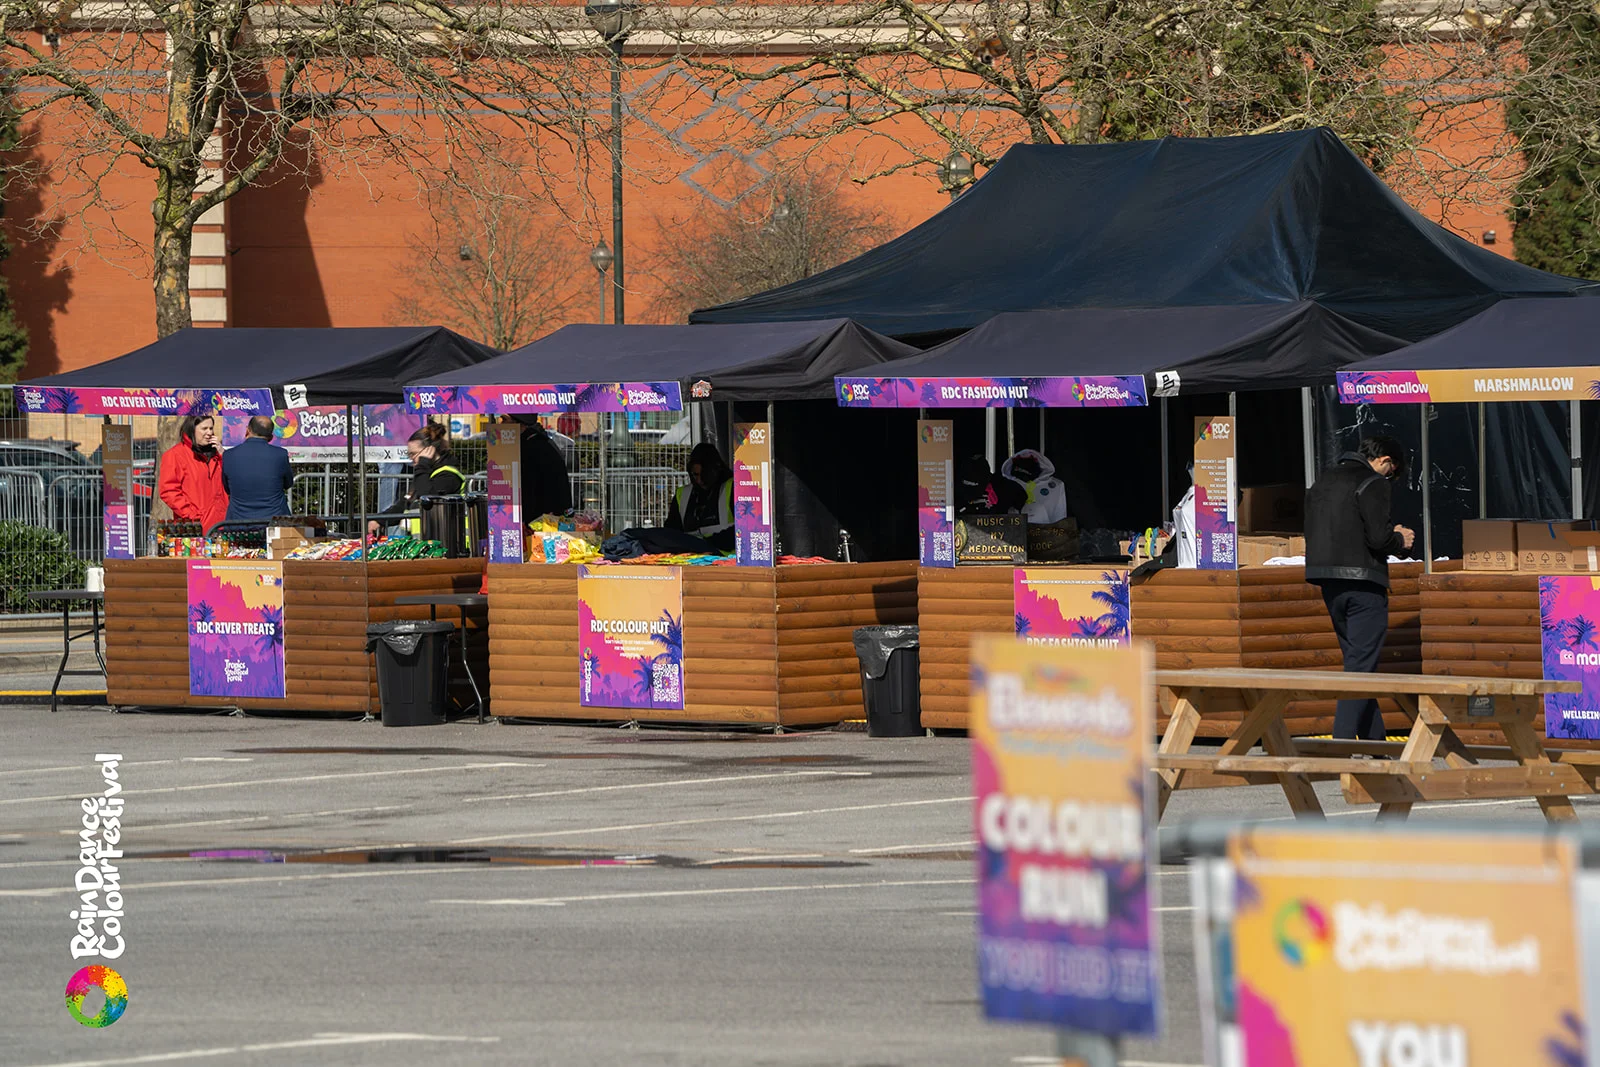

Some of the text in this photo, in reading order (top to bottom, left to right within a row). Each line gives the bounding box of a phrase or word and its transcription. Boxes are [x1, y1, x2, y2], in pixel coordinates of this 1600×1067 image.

[852, 384, 869, 394] RDC
[1356, 382, 1428, 394] marshmallow
[1474, 377, 1574, 392] MARSHMALLOW
[420, 392, 435, 402] RDC
[503, 392, 576, 405] RDC COLOUR HUT
[941, 386, 1028, 399] RDC FASHION HUT
[102, 396, 178, 409] RDC RIVER TREATS
[501, 430, 516, 439] RDC
[750, 428, 765, 439] RDC
[932, 426, 948, 437] RDC
[1212, 423, 1230, 434] RDC
[976, 517, 1020, 526] MUSIC IS
[990, 532, 1005, 540] MY
[968, 545, 1025, 553] MEDICATION
[196, 621, 275, 635] RDC RIVER TREATS
[591, 619, 670, 634] RDC COLOUR HUT
[981, 792, 1142, 860] COLOUR
[1018, 863, 1108, 928] RUN
[1348, 1019, 1468, 1067] YOU
